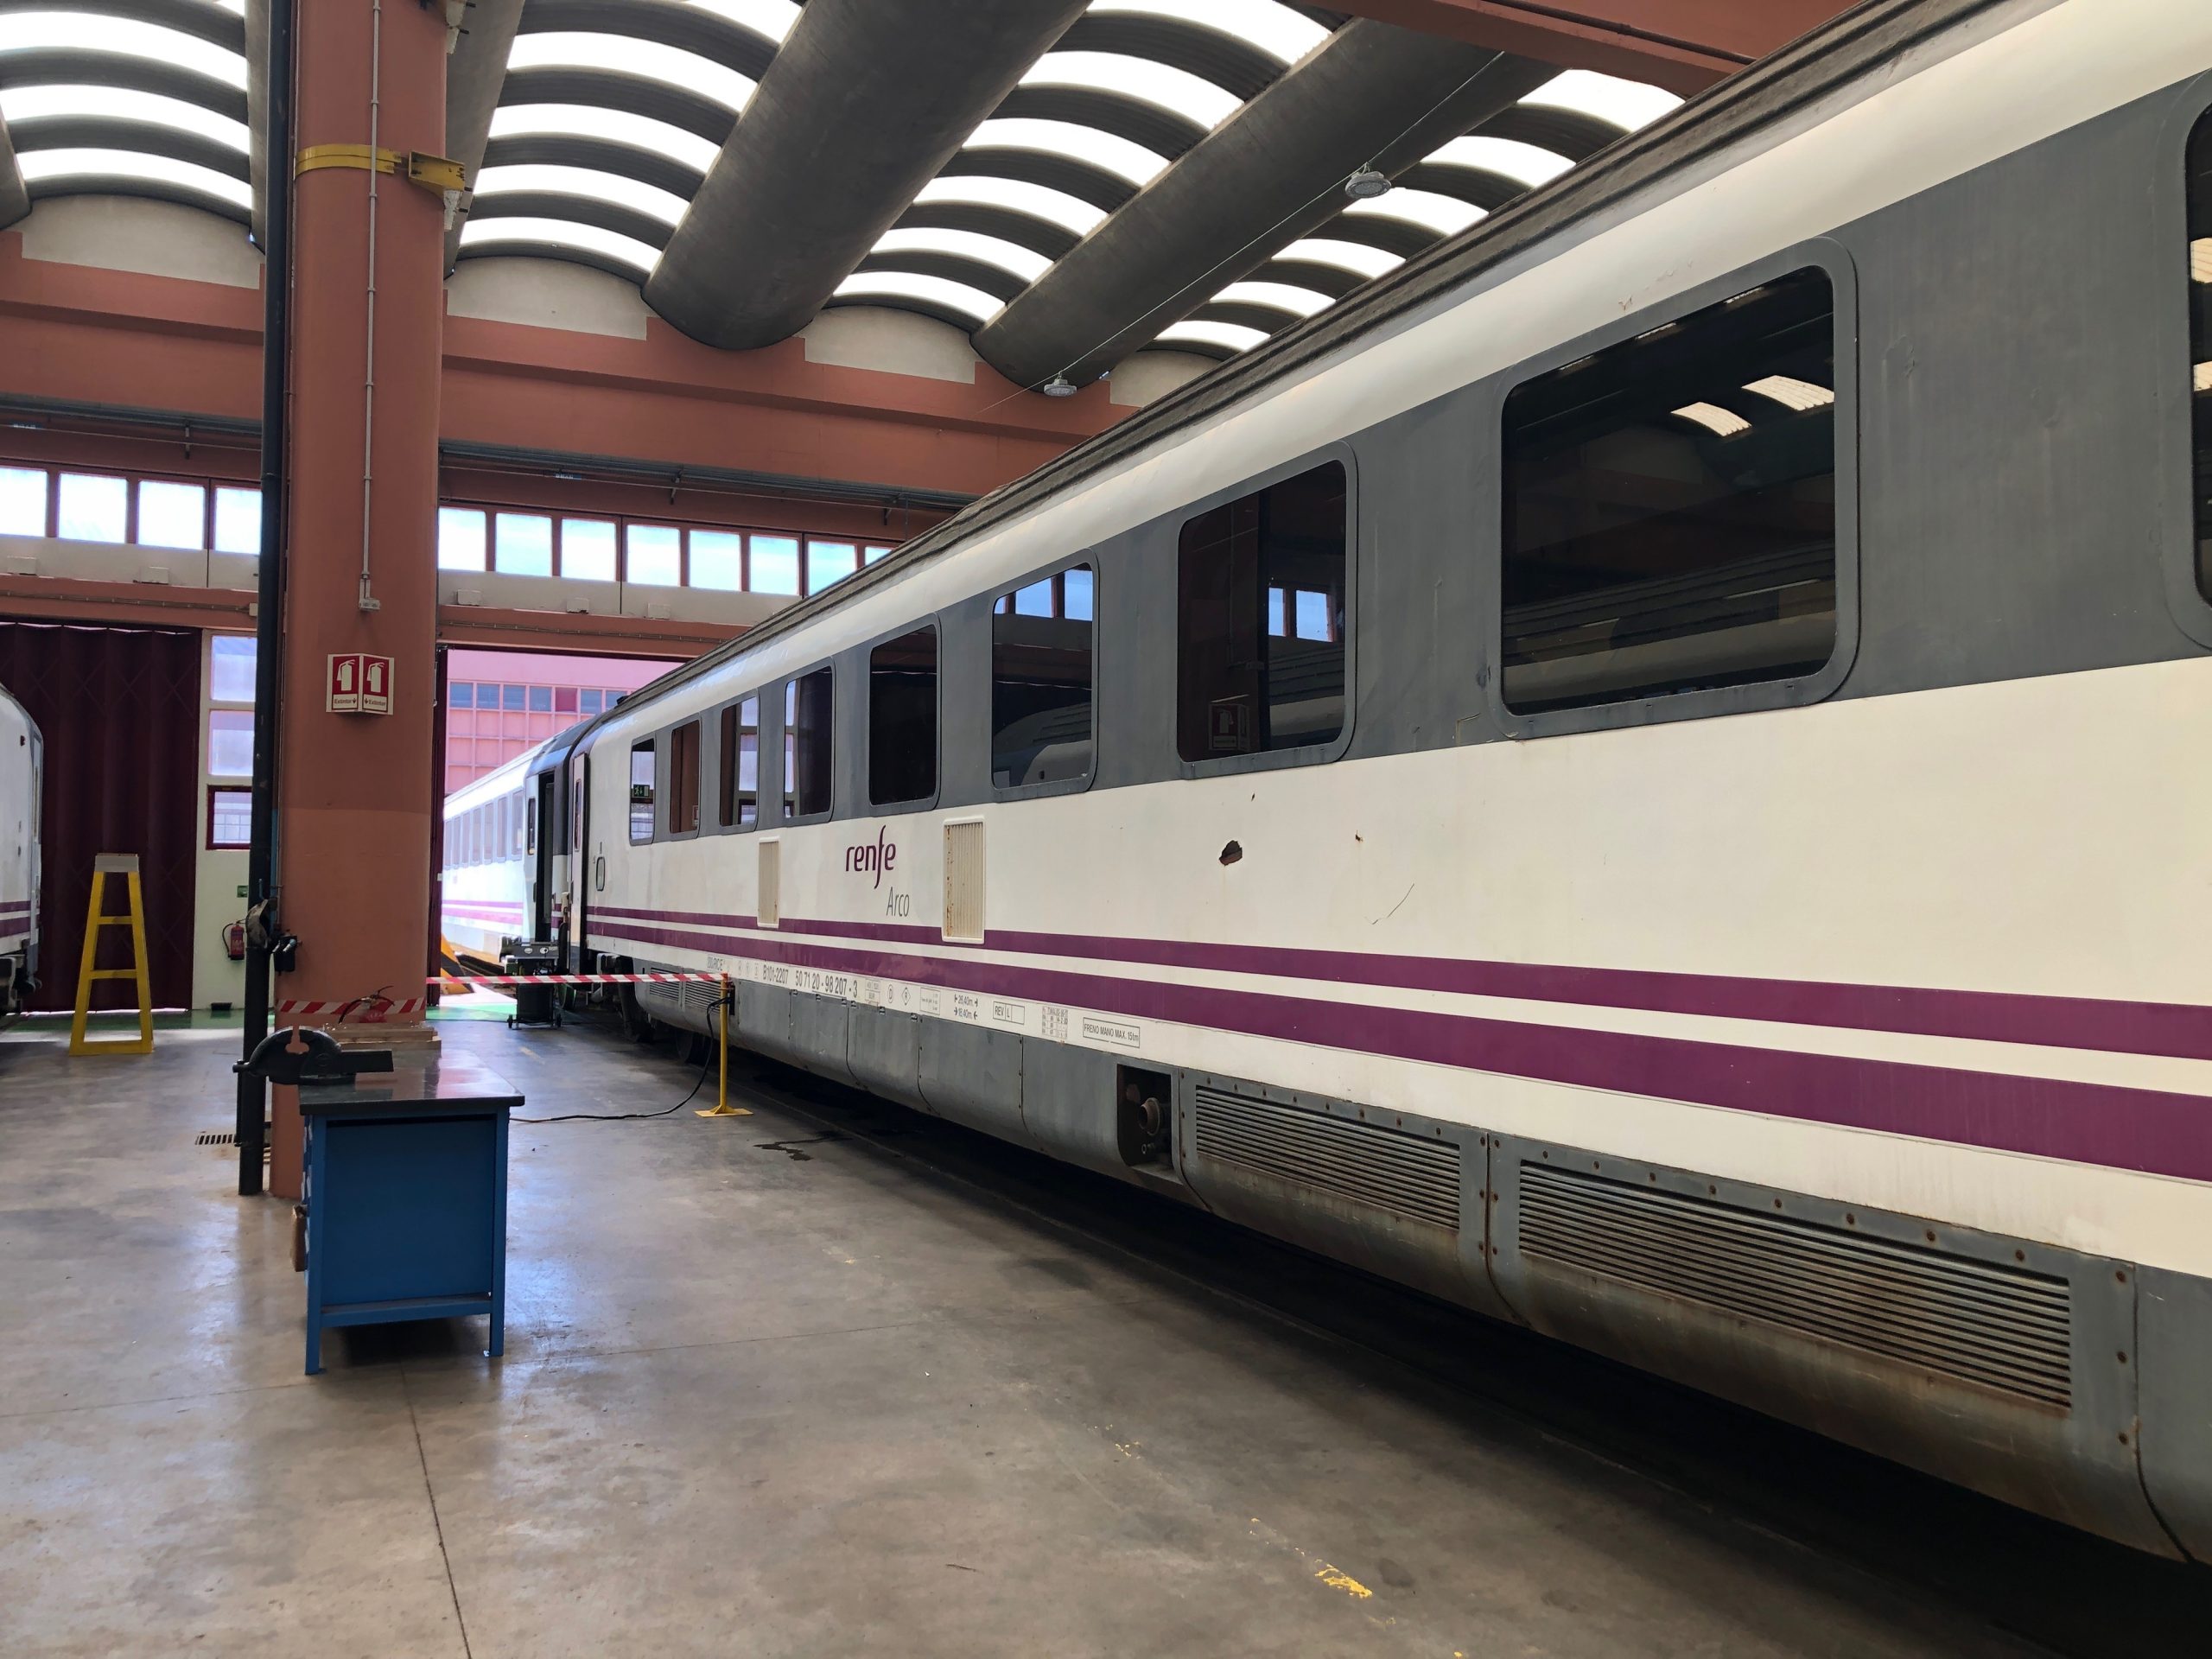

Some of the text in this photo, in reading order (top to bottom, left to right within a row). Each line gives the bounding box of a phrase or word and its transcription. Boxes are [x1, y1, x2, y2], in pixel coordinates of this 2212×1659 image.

[845, 824, 897, 889] renfe
[886, 886, 910, 917] Arco
[795, 970, 803, 987] 50
[804, 971, 810, 988] 71
[812, 973, 820, 990] 20
[825, 975, 833, 993] 98
[835, 976, 848, 995] 207
[853, 980, 858, 998] 3
[995, 1005, 1004, 1017] REV
[1084, 1024, 1099, 1034] FRENO
[1100, 1027, 1114, 1037] MANO
